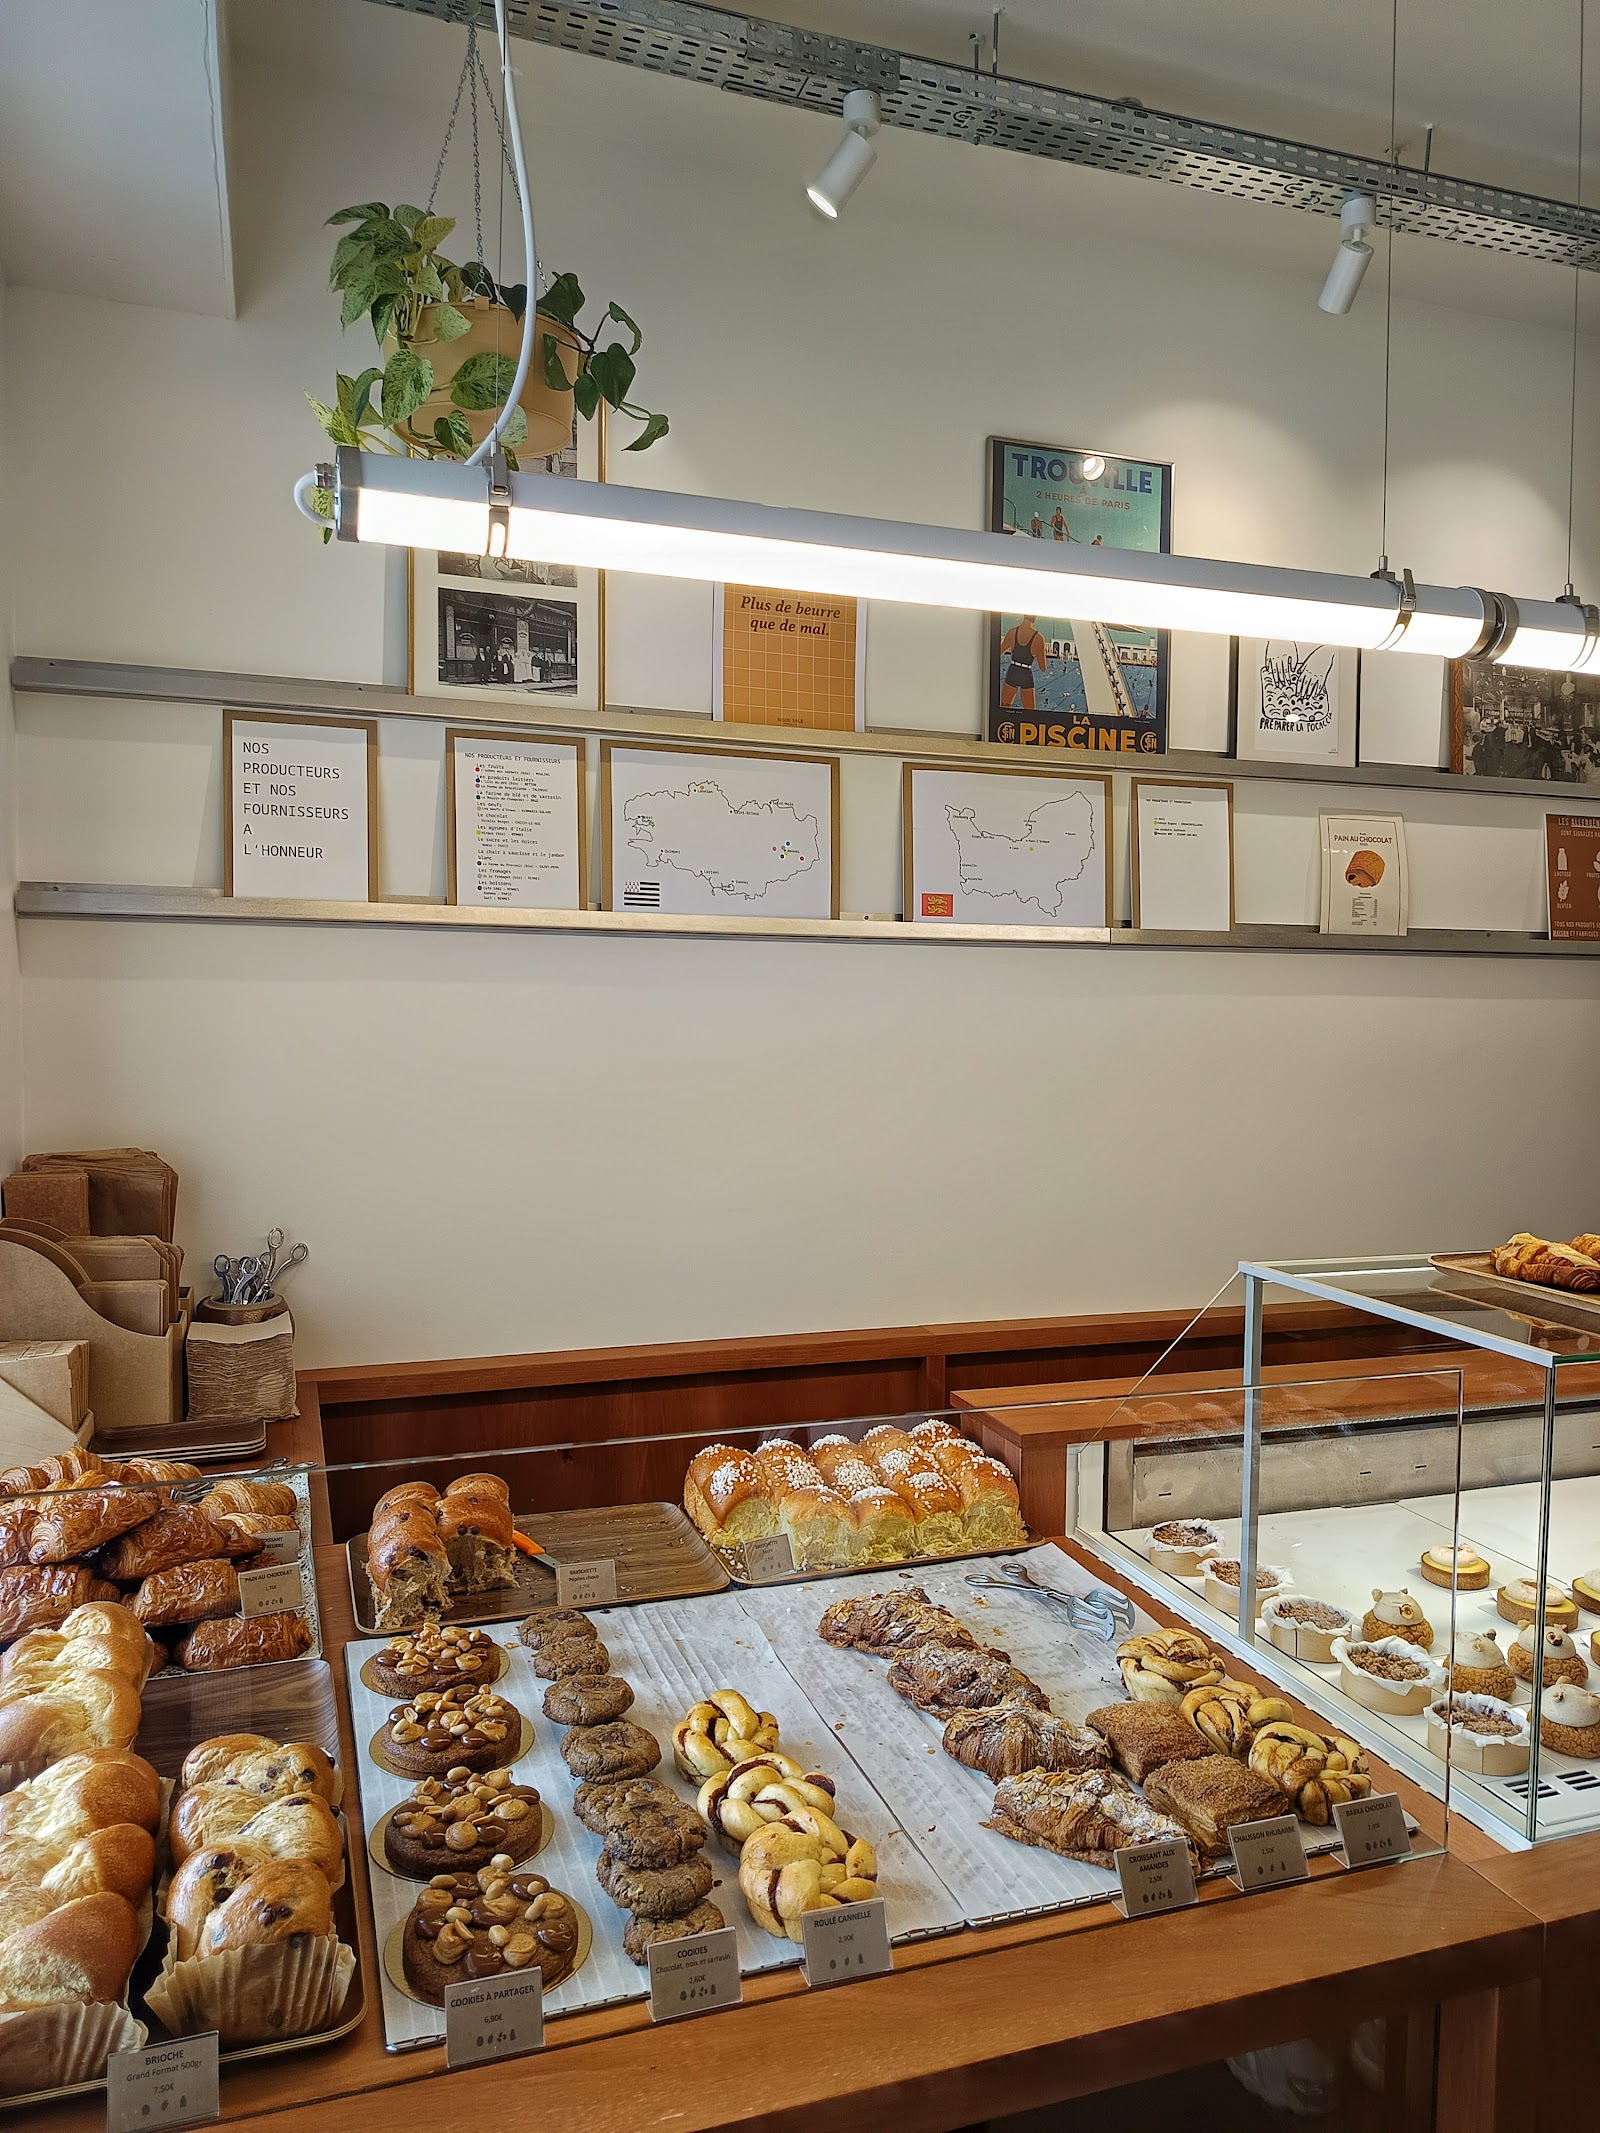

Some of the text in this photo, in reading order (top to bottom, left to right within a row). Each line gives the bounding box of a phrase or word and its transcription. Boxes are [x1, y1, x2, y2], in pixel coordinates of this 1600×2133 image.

[1012, 453, 1152, 494] TROUILLE
[1045, 492, 1081, 503] HEURES
[1101, 500, 1130, 510] PARIS
[740, 596, 841, 618] Plus de beurre
[750, 619, 829, 635] que de mal.
[1073, 715, 1091, 726] LA
[1296, 723, 1304, 731] LA
[1020, 723, 1136, 752] PISCINE
[243, 742, 269, 754] NOS
[243, 762, 340, 779] PRODUCTEURS
[243, 783, 296, 796] ET NOS
[243, 803, 349, 820] FOURNISSEURS
[1558, 817, 1569, 826] LES
[243, 824, 252, 835] A
[244, 844, 323, 858] L'HONNEUR
[267, 1570, 292, 1579] CHOCOLAT
[1346, 1802, 1392, 1816] BABKA CHOCOLAT
[1234, 1826, 1295, 1843] CHAUSSON RHUBARBE
[1129, 1851, 1161, 1863] CROISSANT
[1140, 1861, 1169, 1872] AMANDES
[814, 1910, 871, 1928] ROULÉ CANNELLE
[677, 1946, 708, 1958] COOKIES
[656, 1964, 684, 1974] Chocolat,
[686, 1960, 698, 1968] noix
[707, 1954, 730, 1964] sarrasin
[451, 1985, 534, 2008] COOKIES À PARTAGER
[484, 2014, 503, 2024] 6,90€
[146, 2050, 184, 2066] BRIOCHE
[126, 2060, 202, 2081] Grand Format 500gr
